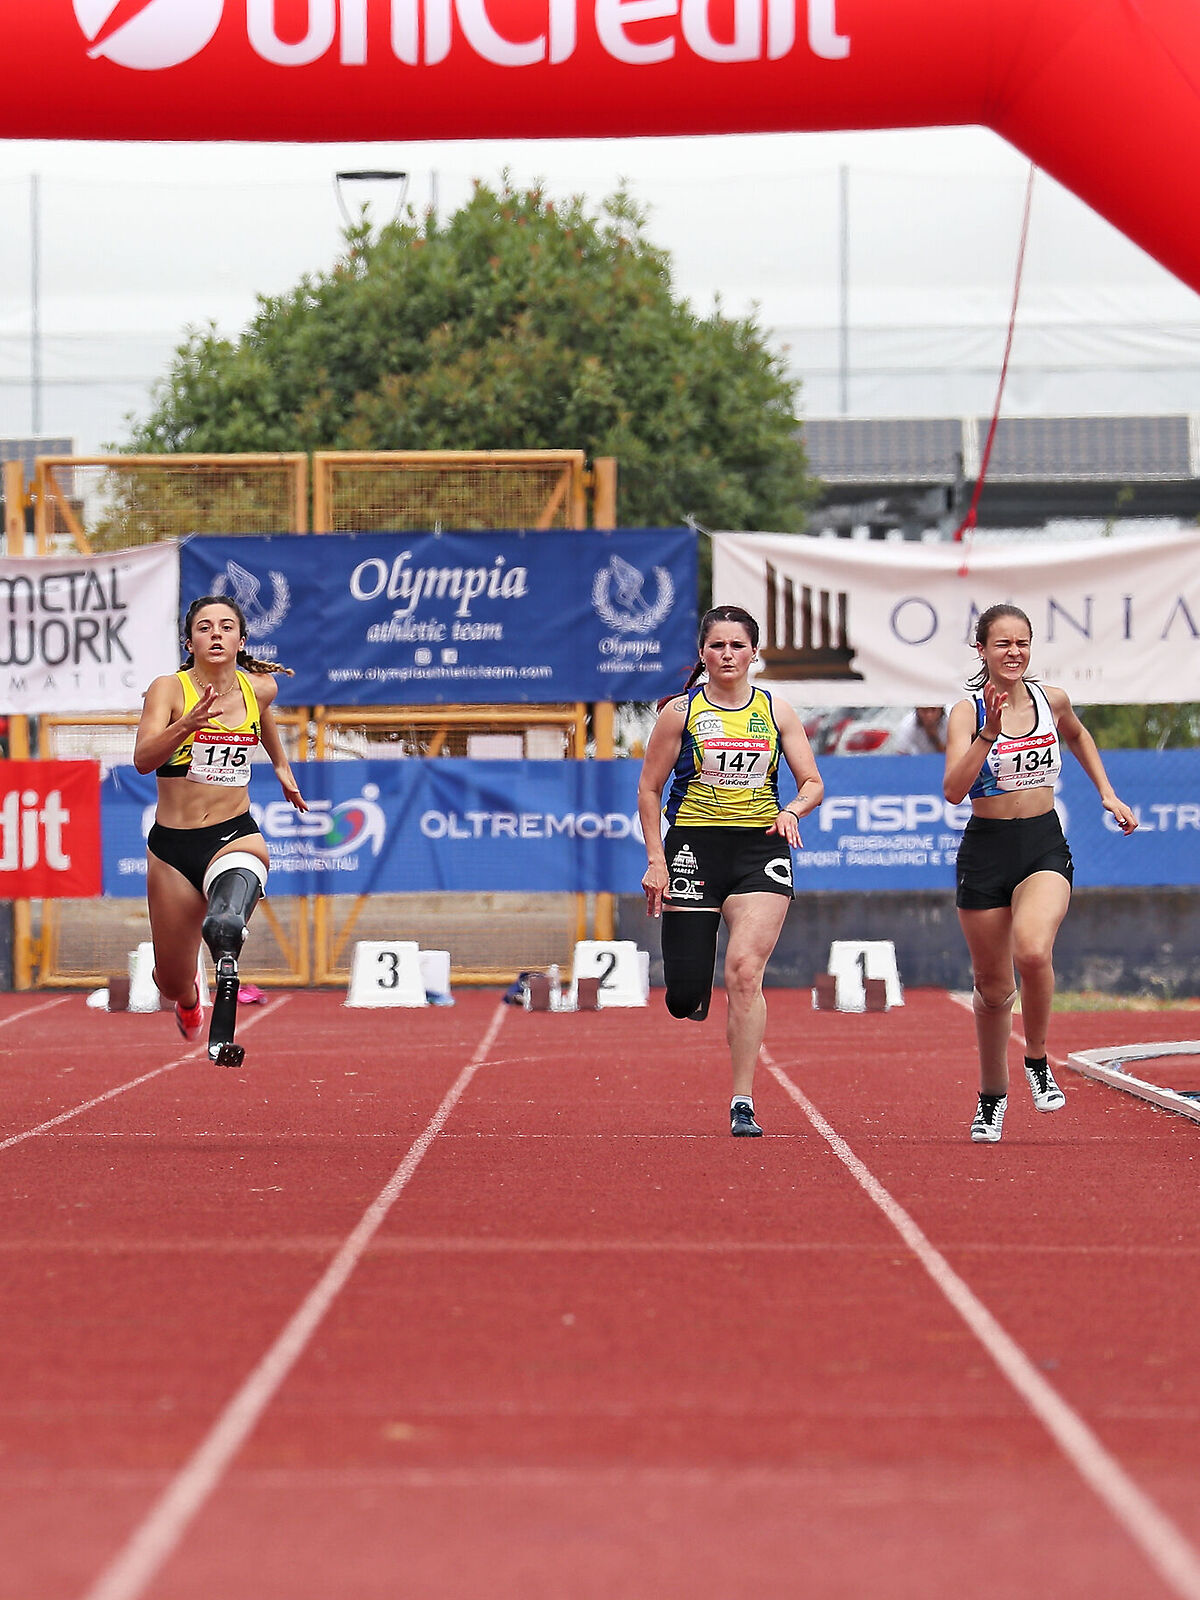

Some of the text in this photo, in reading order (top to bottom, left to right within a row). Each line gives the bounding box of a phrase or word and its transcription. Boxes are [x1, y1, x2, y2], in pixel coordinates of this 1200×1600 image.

[349, 550, 529, 618] Olympia
[366, 615, 503, 642] athletic team
[889, 593, 1200, 645] ONIA
[598, 634, 661, 661] Olympia
[204, 745, 248, 767] 115
[716, 751, 760, 772] 147
[1012, 747, 1054, 772] 134
[1022, 777, 1045, 786] UniCredit
[420, 810, 647, 843] OLTREMOD
[819, 793, 973, 832] FISPE
[377, 951, 399, 988] 3
[596, 951, 617, 990] 2
[855, 951, 866, 989] 1
